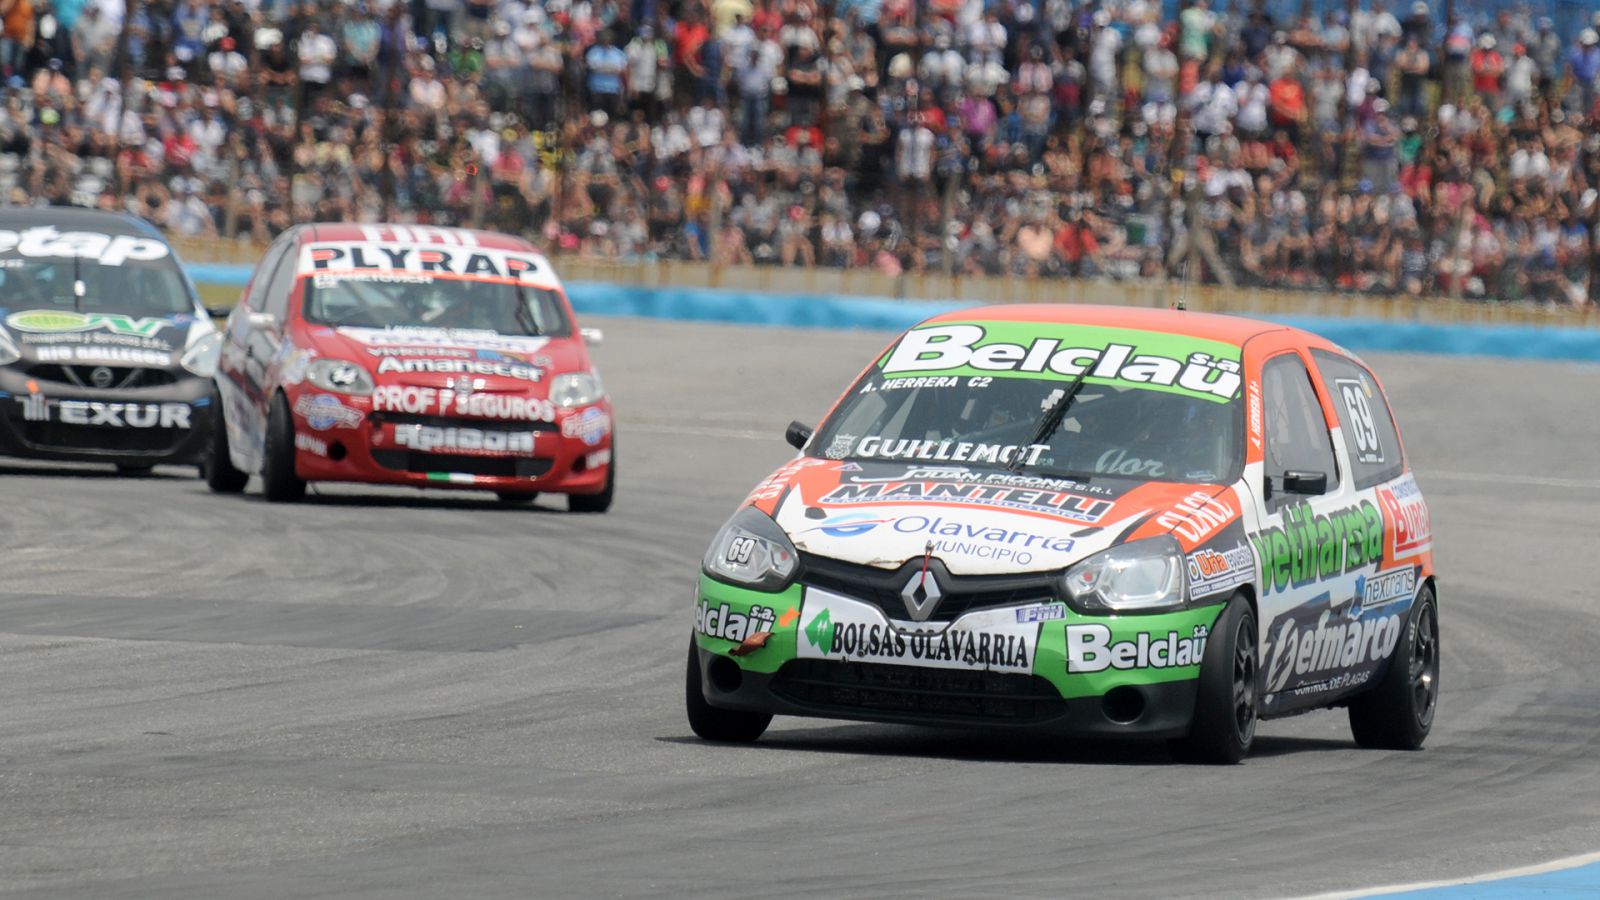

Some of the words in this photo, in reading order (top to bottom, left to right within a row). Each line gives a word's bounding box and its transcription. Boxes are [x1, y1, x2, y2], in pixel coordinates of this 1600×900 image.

[311, 247, 537, 279] PLYRAP
[377, 357, 545, 382] Amanecer
[882, 323, 1242, 400] Belclau
[860, 382, 877, 394] A.
[880, 376, 959, 391] HERRERA
[967, 376, 993, 388] C2
[373, 385, 436, 414] PROF
[456, 393, 556, 422] SEGUROS
[1343, 386, 1378, 451] 69
[856, 435, 1050, 466] GUILLEMOT
[913, 471, 982, 482] JUAN
[984, 473, 1077, 490] PICONE
[824, 482, 1115, 518] MANTELLI
[727, 537, 756, 563] 69
[926, 540, 1033, 566] MUNICIPIO
[1253, 500, 1383, 593] vetifarma
[1364, 570, 1415, 604] nextrans
[831, 621, 906, 658] BOLSAS
[911, 628, 1029, 668] OLAVARRIA
[1065, 623, 1207, 674] Belclau
[1342, 670, 1371, 687] PLAGAS
